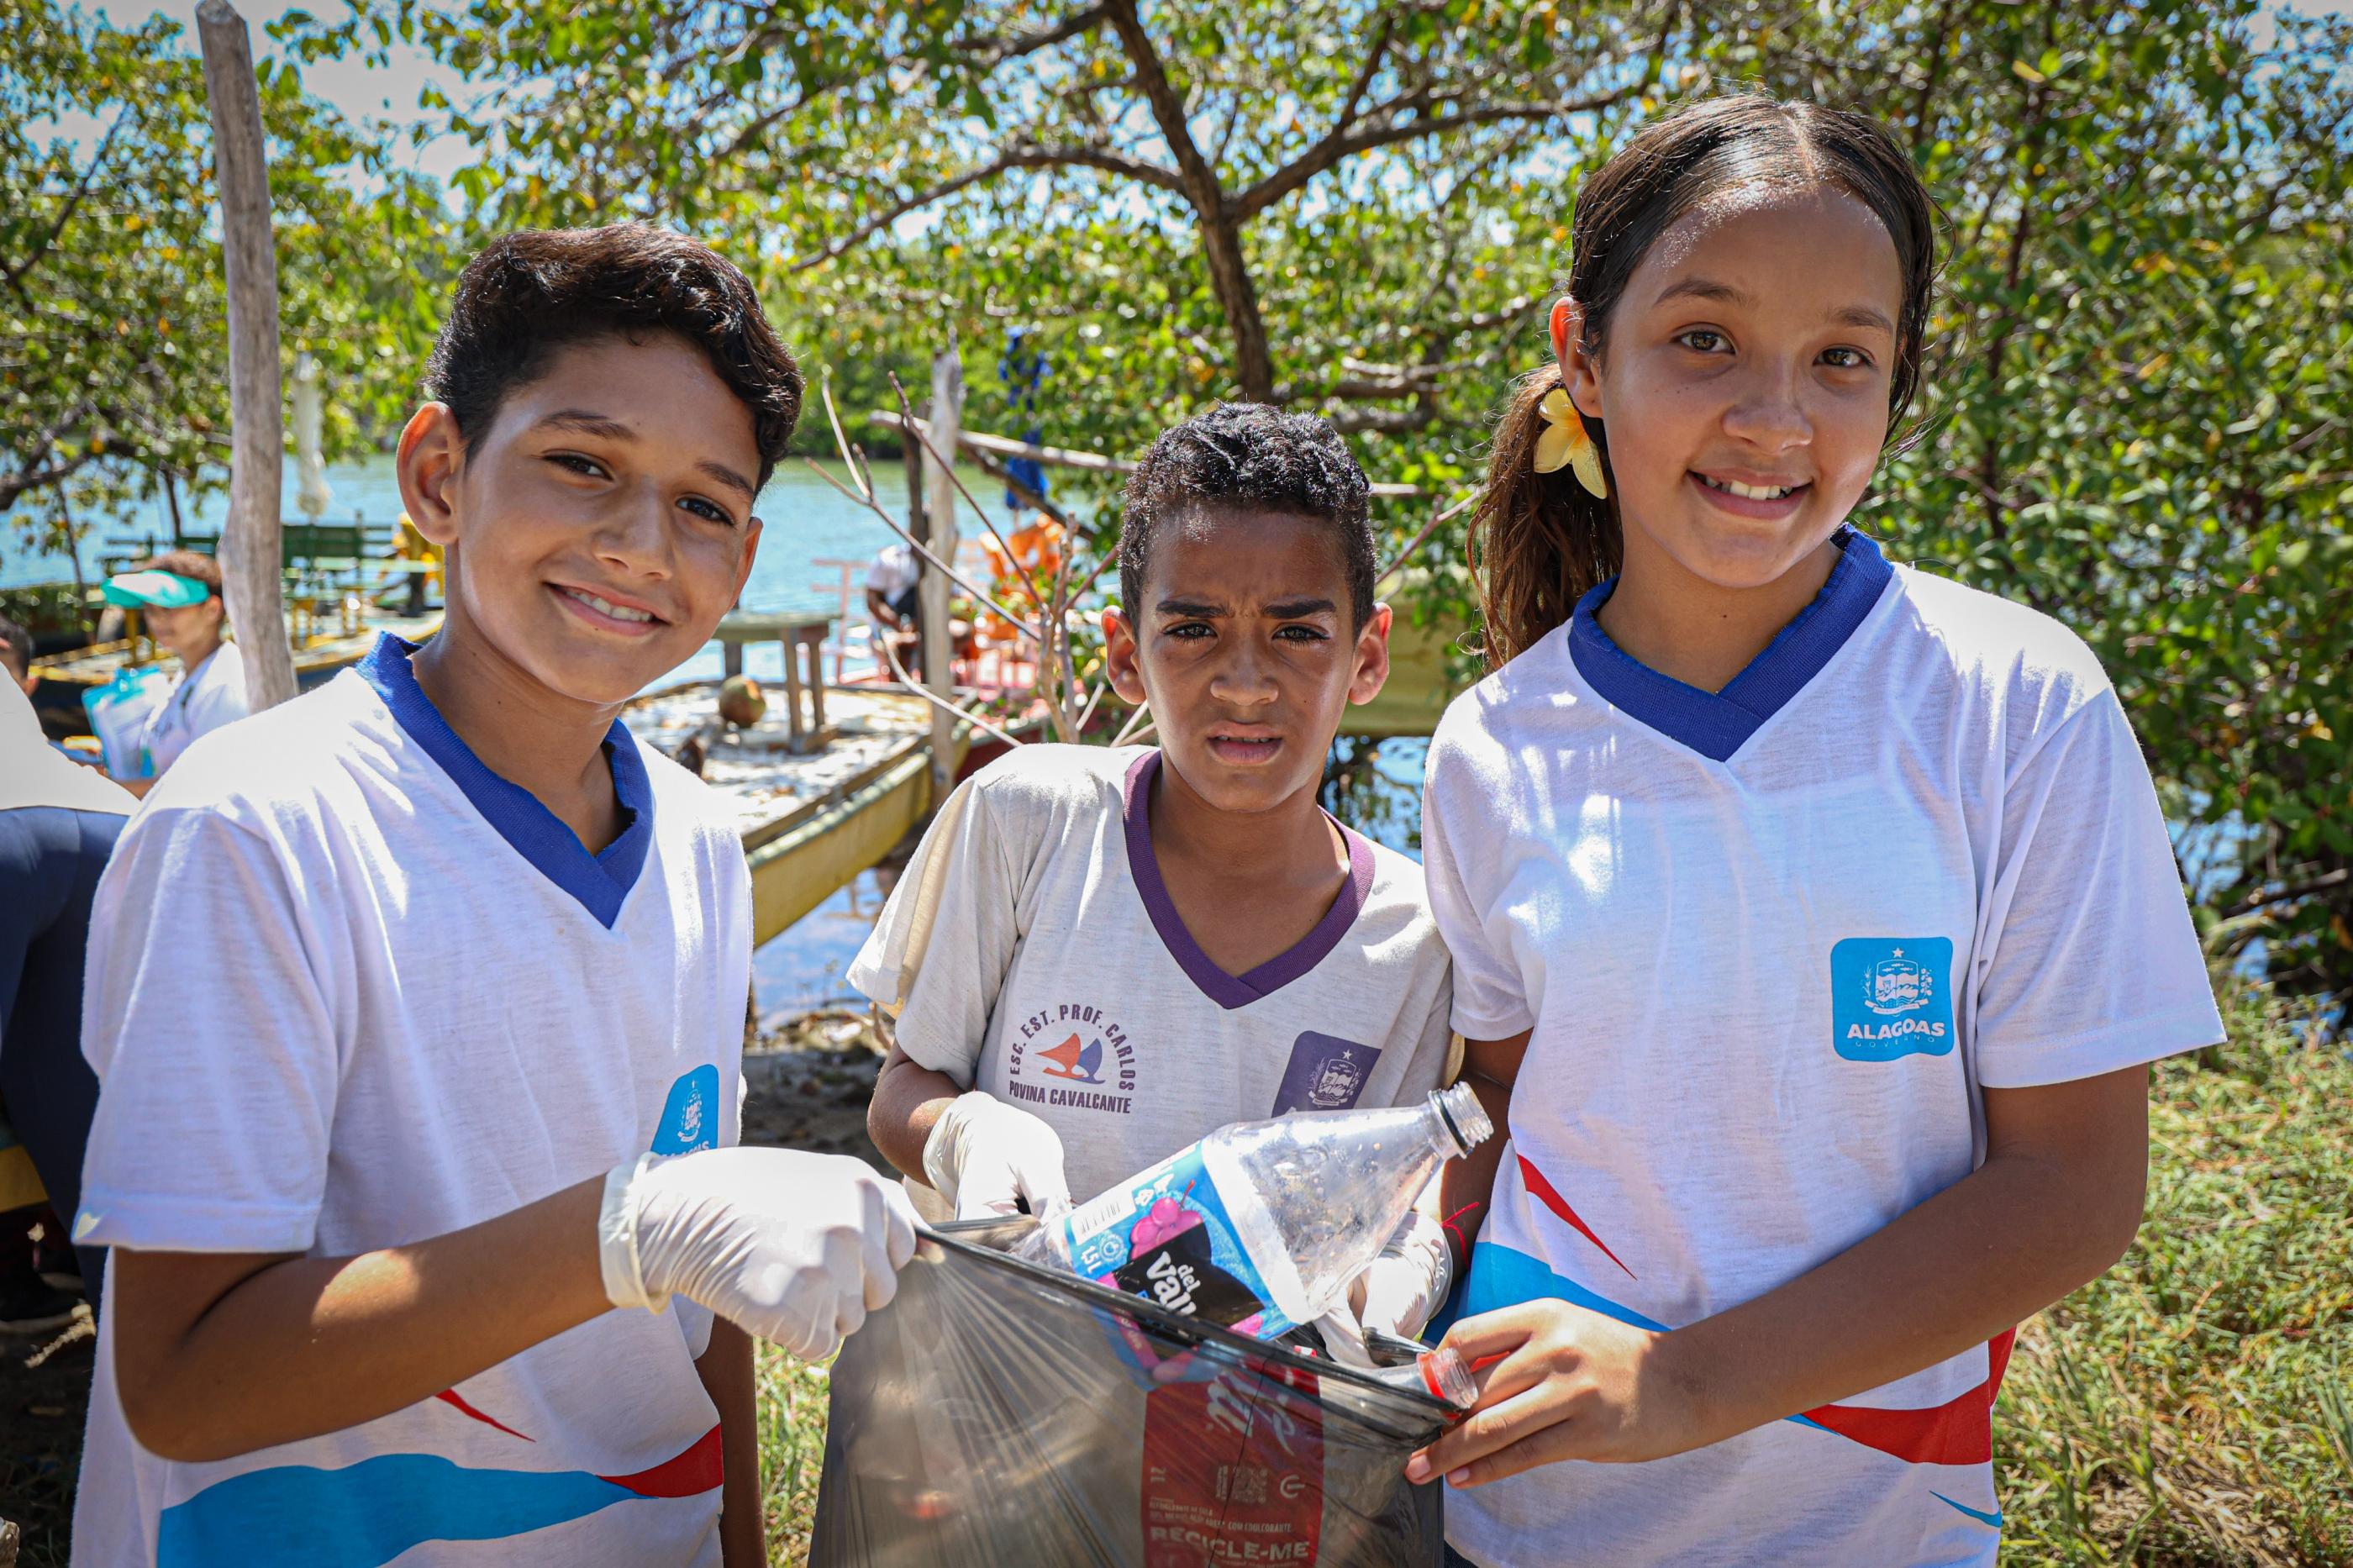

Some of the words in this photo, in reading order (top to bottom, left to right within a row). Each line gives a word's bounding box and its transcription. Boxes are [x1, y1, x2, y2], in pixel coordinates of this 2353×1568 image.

[1847, 1018, 1945, 1039] ALAGOAS
[1010, 1043, 1026, 1075] ESC.
[1020, 1010, 1055, 1039] EST.
[1059, 1004, 1103, 1029] PROF.
[1105, 1023, 1136, 1091] CARLOS
[1009, 1081, 1045, 1103] POVINA
[1049, 1089, 1132, 1113] CAVALCANTE
[1146, 1250, 1198, 1317] Vall
[1177, 1264, 1201, 1293] del
[1150, 1526, 1310, 1560] RECICLE-ME
